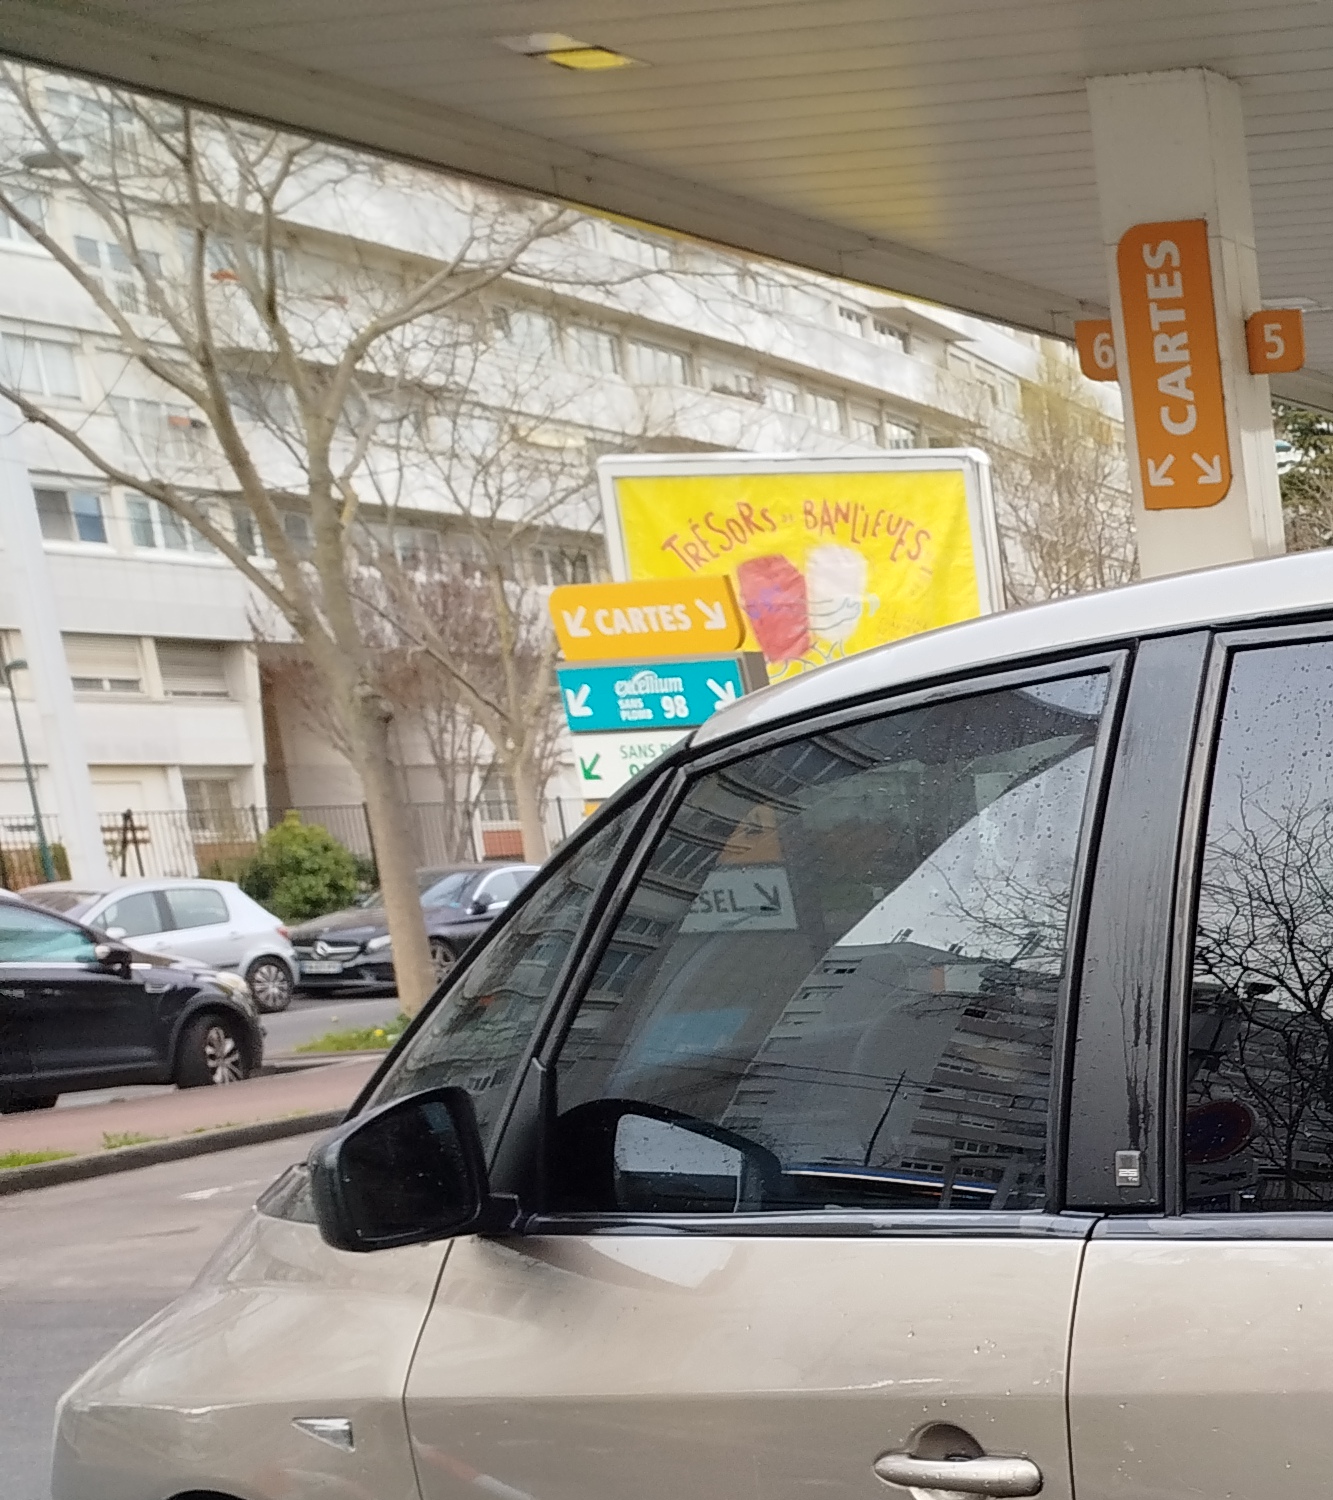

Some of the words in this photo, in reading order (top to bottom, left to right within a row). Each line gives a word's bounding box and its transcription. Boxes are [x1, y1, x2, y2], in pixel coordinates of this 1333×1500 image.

[1093, 332, 1115, 370] 6
[1142, 239, 1198, 436] CARTES
[1263, 323, 1285, 360] 5
[593, 603, 693, 636] CARTES
[660, 695, 690, 719] 98
[619, 744, 656, 760] SANS
